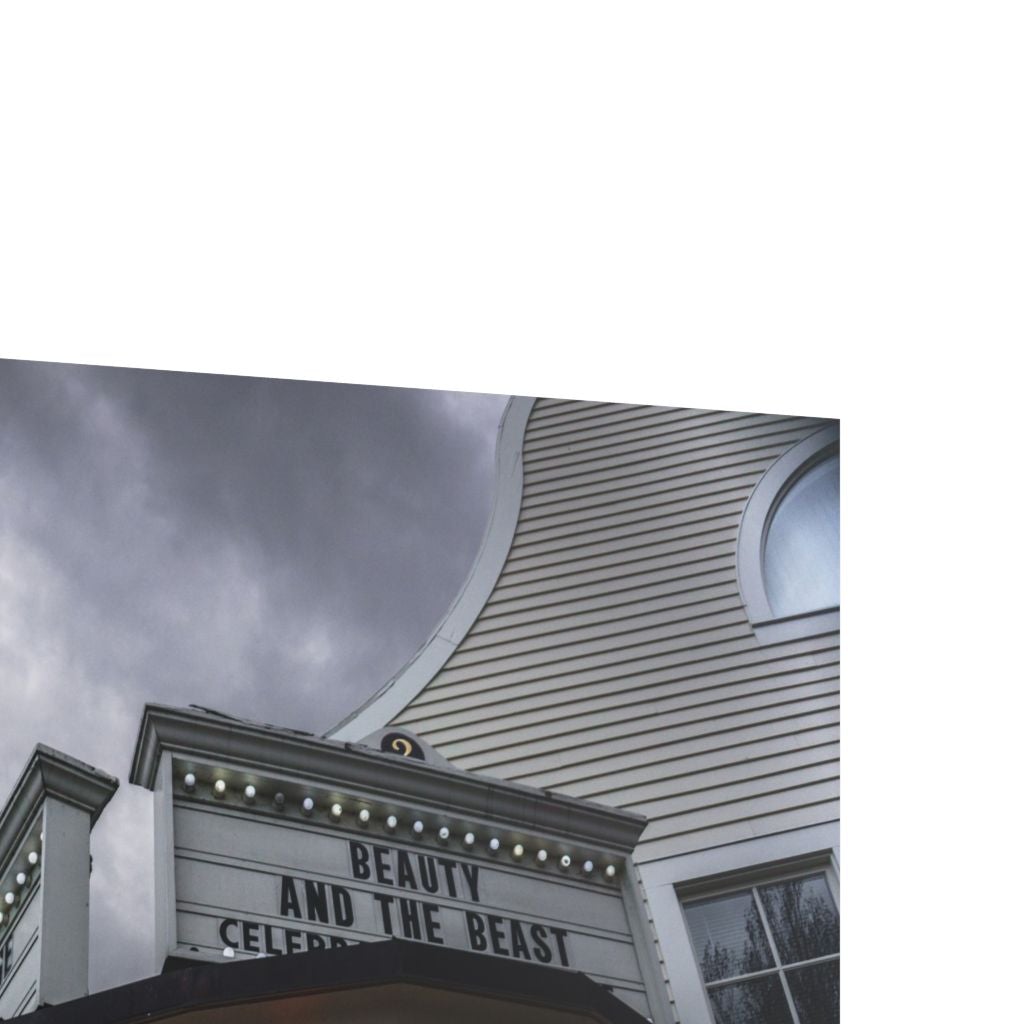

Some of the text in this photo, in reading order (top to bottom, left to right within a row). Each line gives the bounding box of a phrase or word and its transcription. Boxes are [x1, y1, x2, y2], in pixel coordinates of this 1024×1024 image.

[350, 840, 480, 902] BEAUTY
[280, 876, 569, 967] AND THE BEAST
